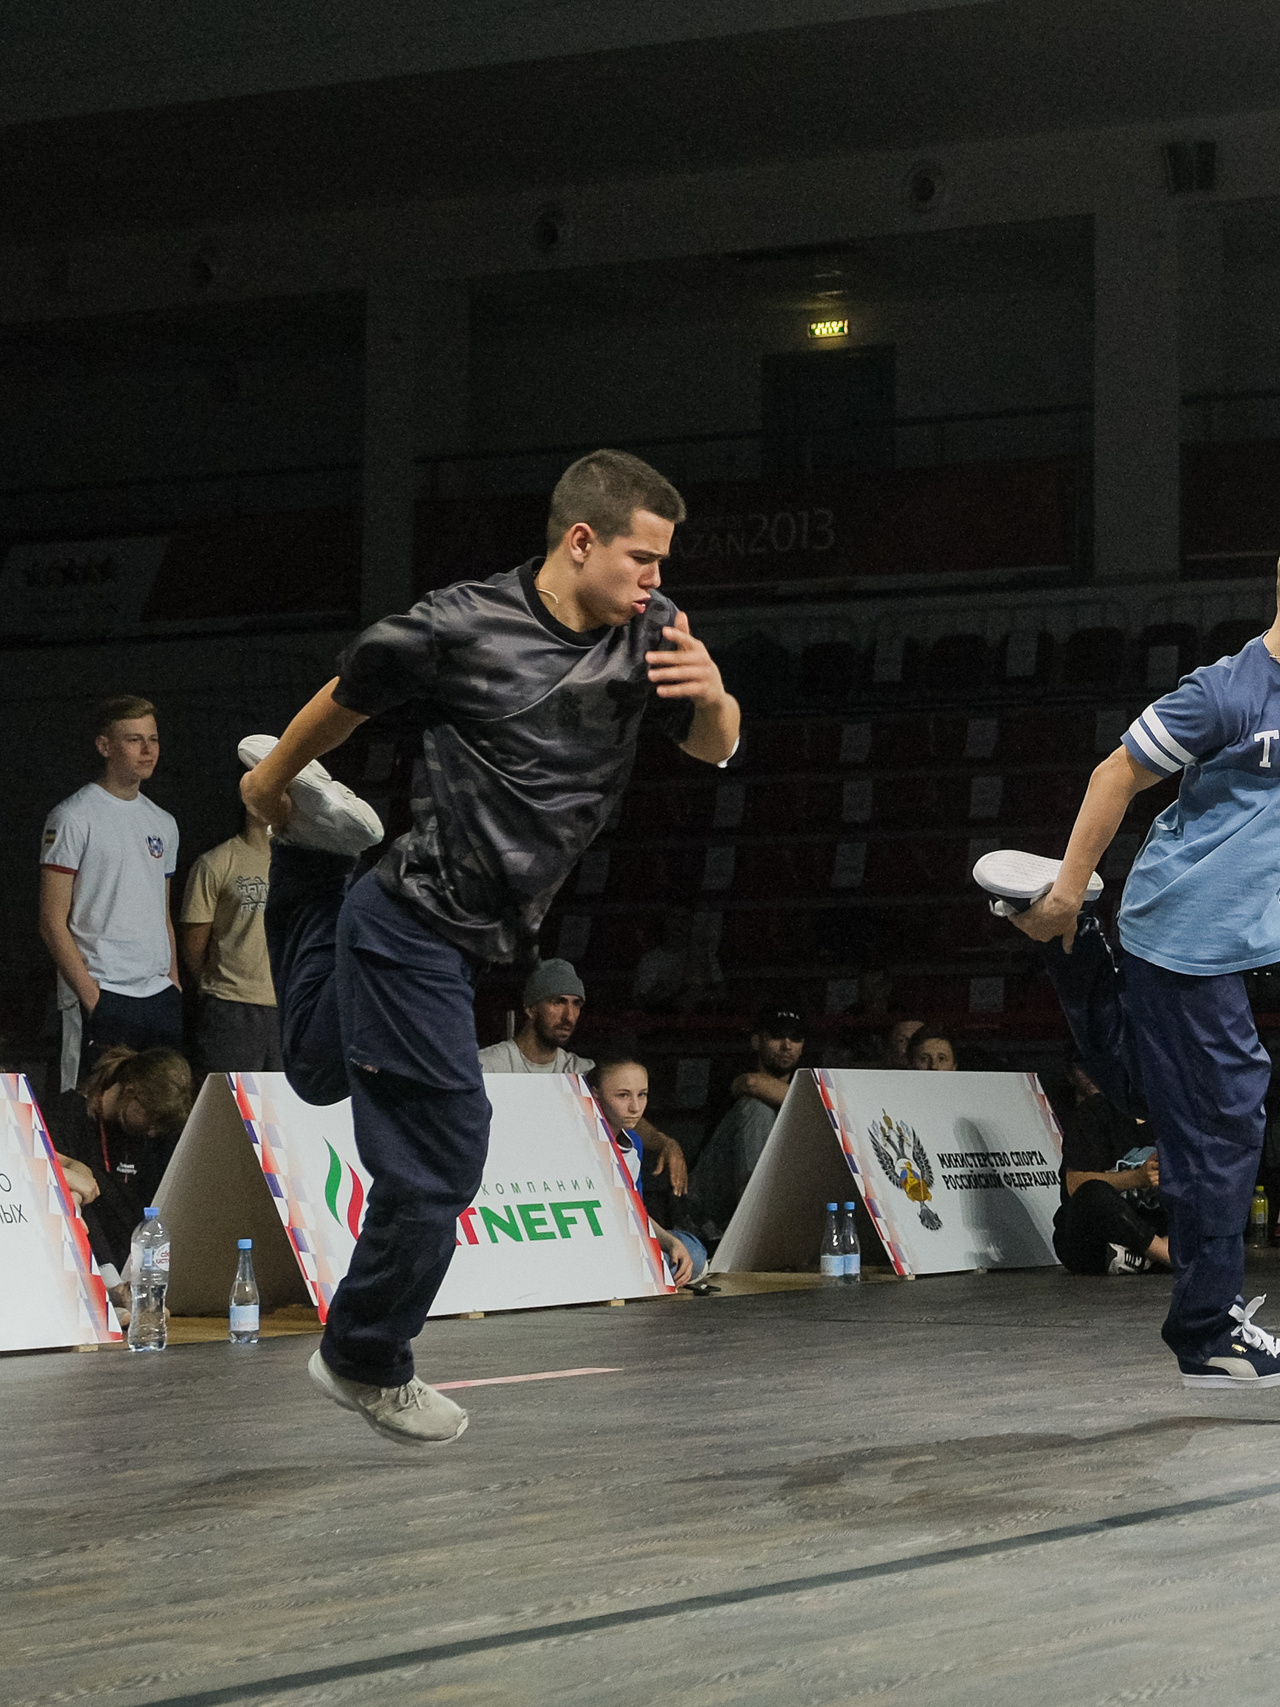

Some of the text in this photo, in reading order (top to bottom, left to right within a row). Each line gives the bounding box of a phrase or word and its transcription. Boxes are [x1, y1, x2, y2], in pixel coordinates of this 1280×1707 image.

[936, 1150, 1048, 1169] МИНИСТЕРСТВО СПОРТА
[480, 1176, 596, 1196] КОМПАНИЙ
[941, 1169, 1061, 1191] РОССИЙСКОЙ ФЕДЕРАЦИИ
[0, 1203, 28, 1224] ЫХ
[456, 1199, 604, 1246] TNEFT
